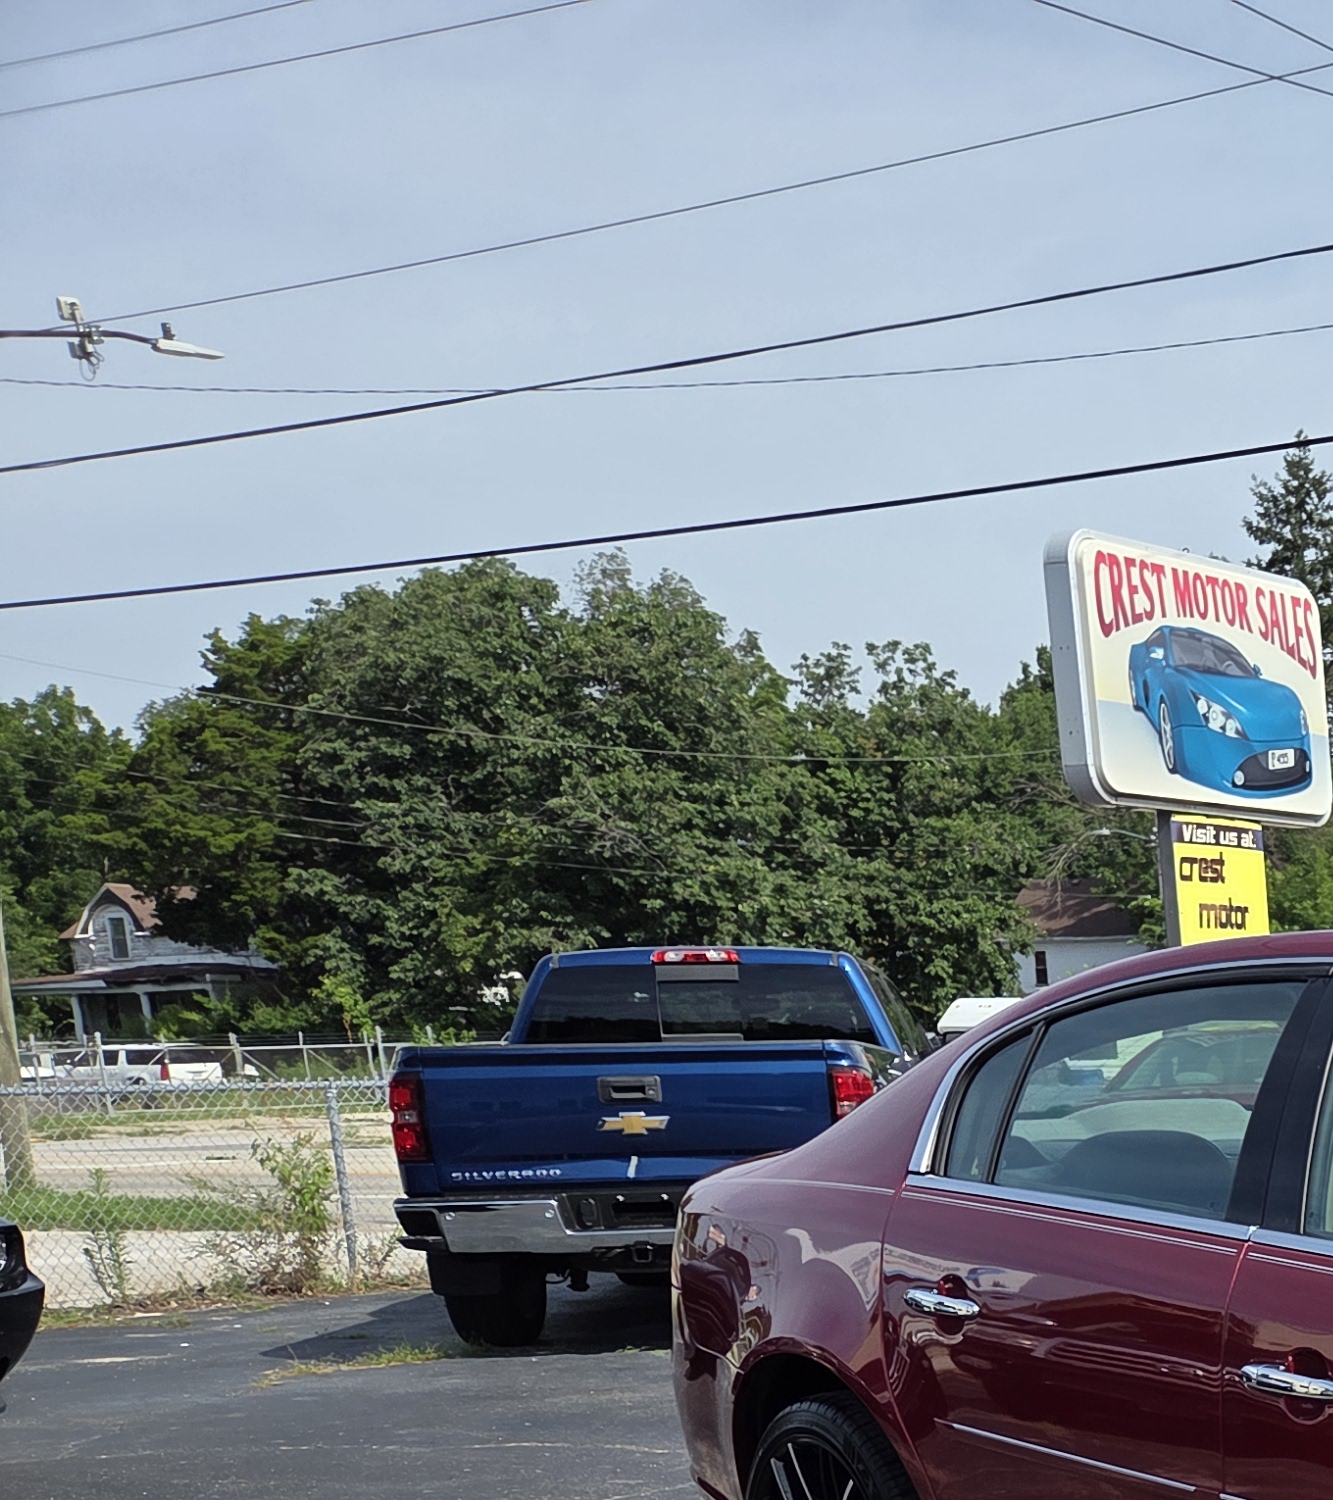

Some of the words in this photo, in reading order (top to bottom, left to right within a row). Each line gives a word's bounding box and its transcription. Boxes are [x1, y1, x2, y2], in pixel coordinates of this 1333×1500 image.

[1094, 550, 1166, 637] CREST
[1171, 567, 1253, 634] MOTOR
[1256, 586, 1317, 680] SALES
[1182, 824, 1216, 844] Visit
[1219, 831, 1238, 845] us
[1180, 851, 1225, 884] crest
[1199, 897, 1249, 931] motor
[451, 1169, 562, 1181] SILVERADO
